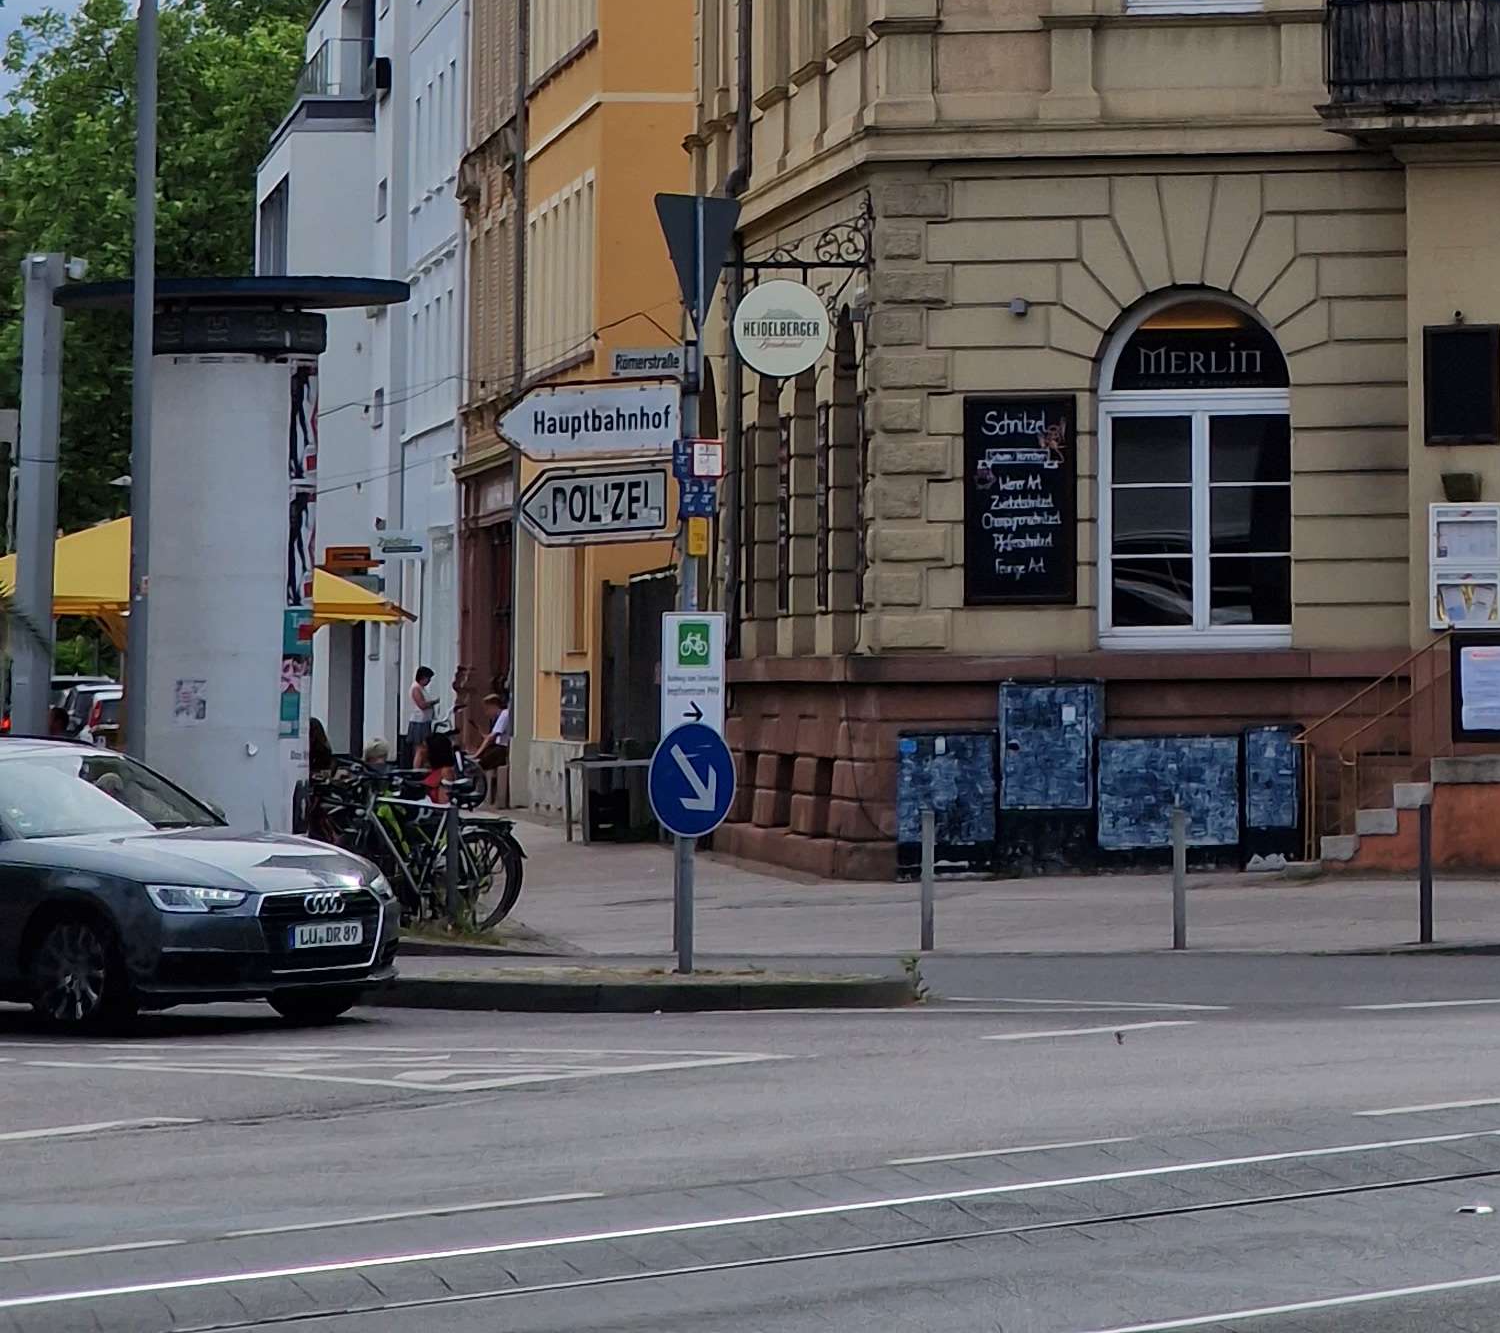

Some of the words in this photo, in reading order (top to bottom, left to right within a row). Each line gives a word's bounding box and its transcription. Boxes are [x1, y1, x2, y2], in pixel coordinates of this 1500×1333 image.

[742, 320, 821, 338] HEIDELBERGER
[532, 404, 671, 441] Hauptbahnhof
[981, 409, 1047, 436] Schnitzel
[300, 928, 318, 946] LU
[342, 925, 359, 943] 89
